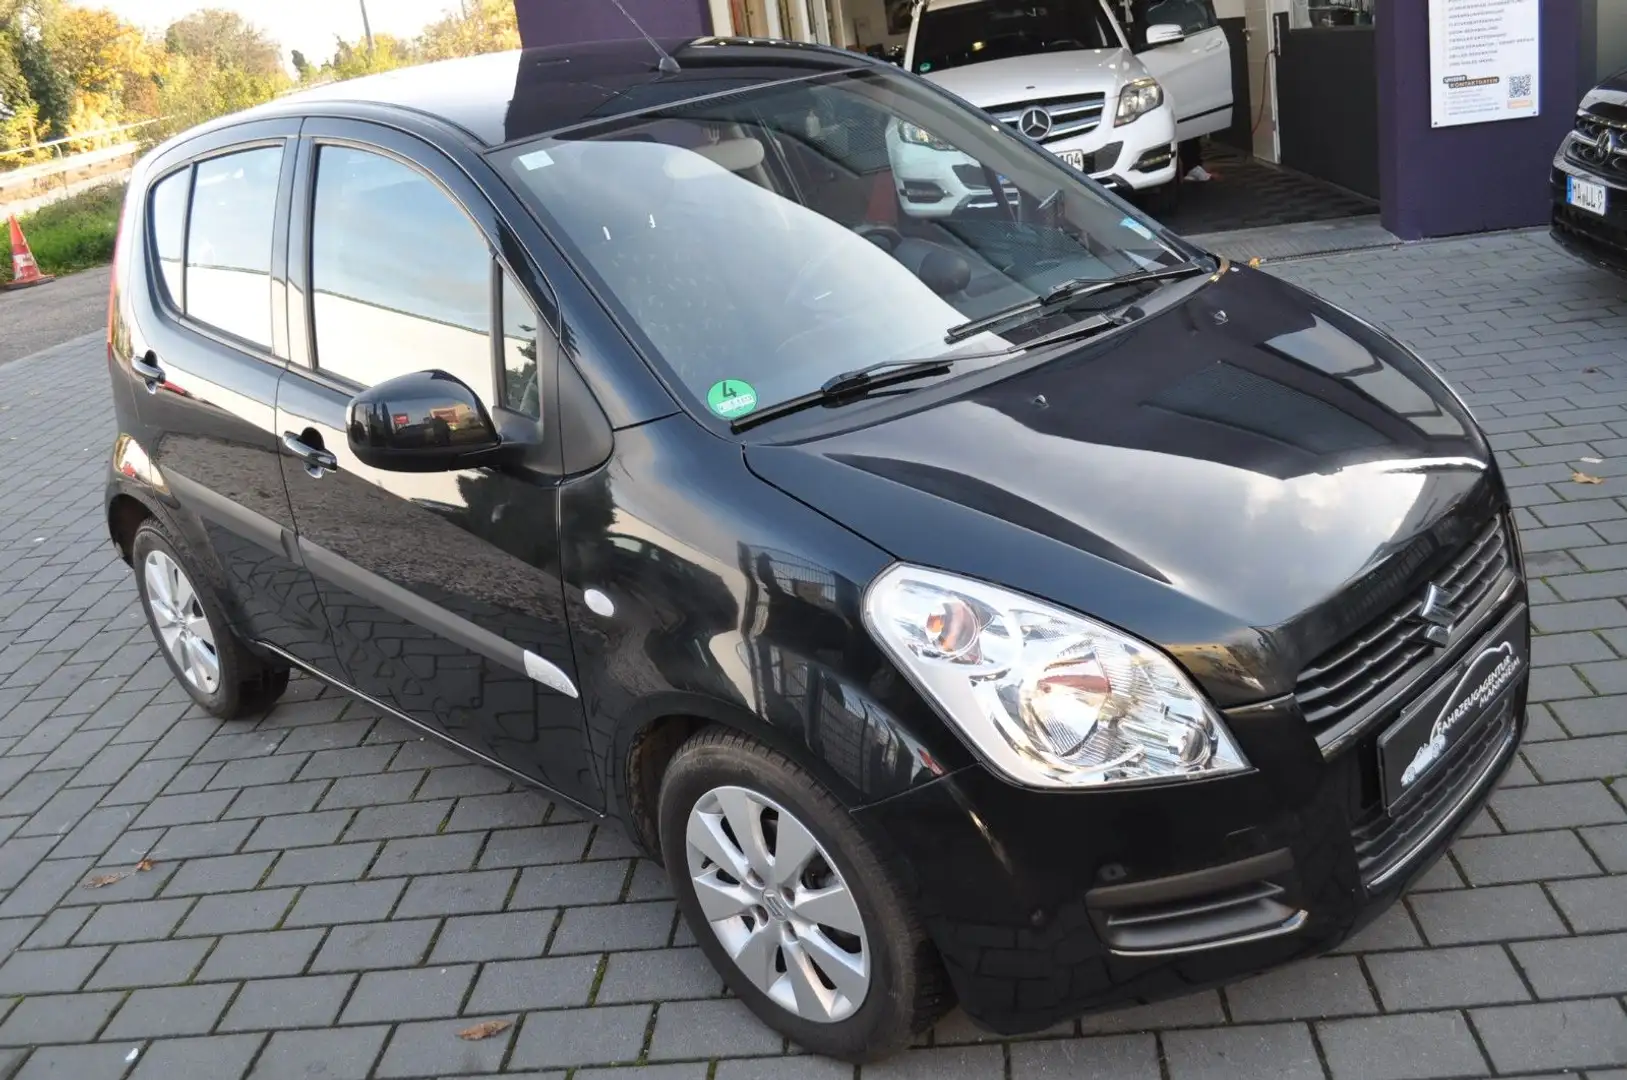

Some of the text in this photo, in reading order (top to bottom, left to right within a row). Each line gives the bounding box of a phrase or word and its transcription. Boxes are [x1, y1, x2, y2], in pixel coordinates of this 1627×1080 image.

[722, 381, 737, 397] 4
[1437, 655, 1511, 733] FAHRZEUGAGENTUR
[1479, 656, 1520, 708] MANNHEIM
